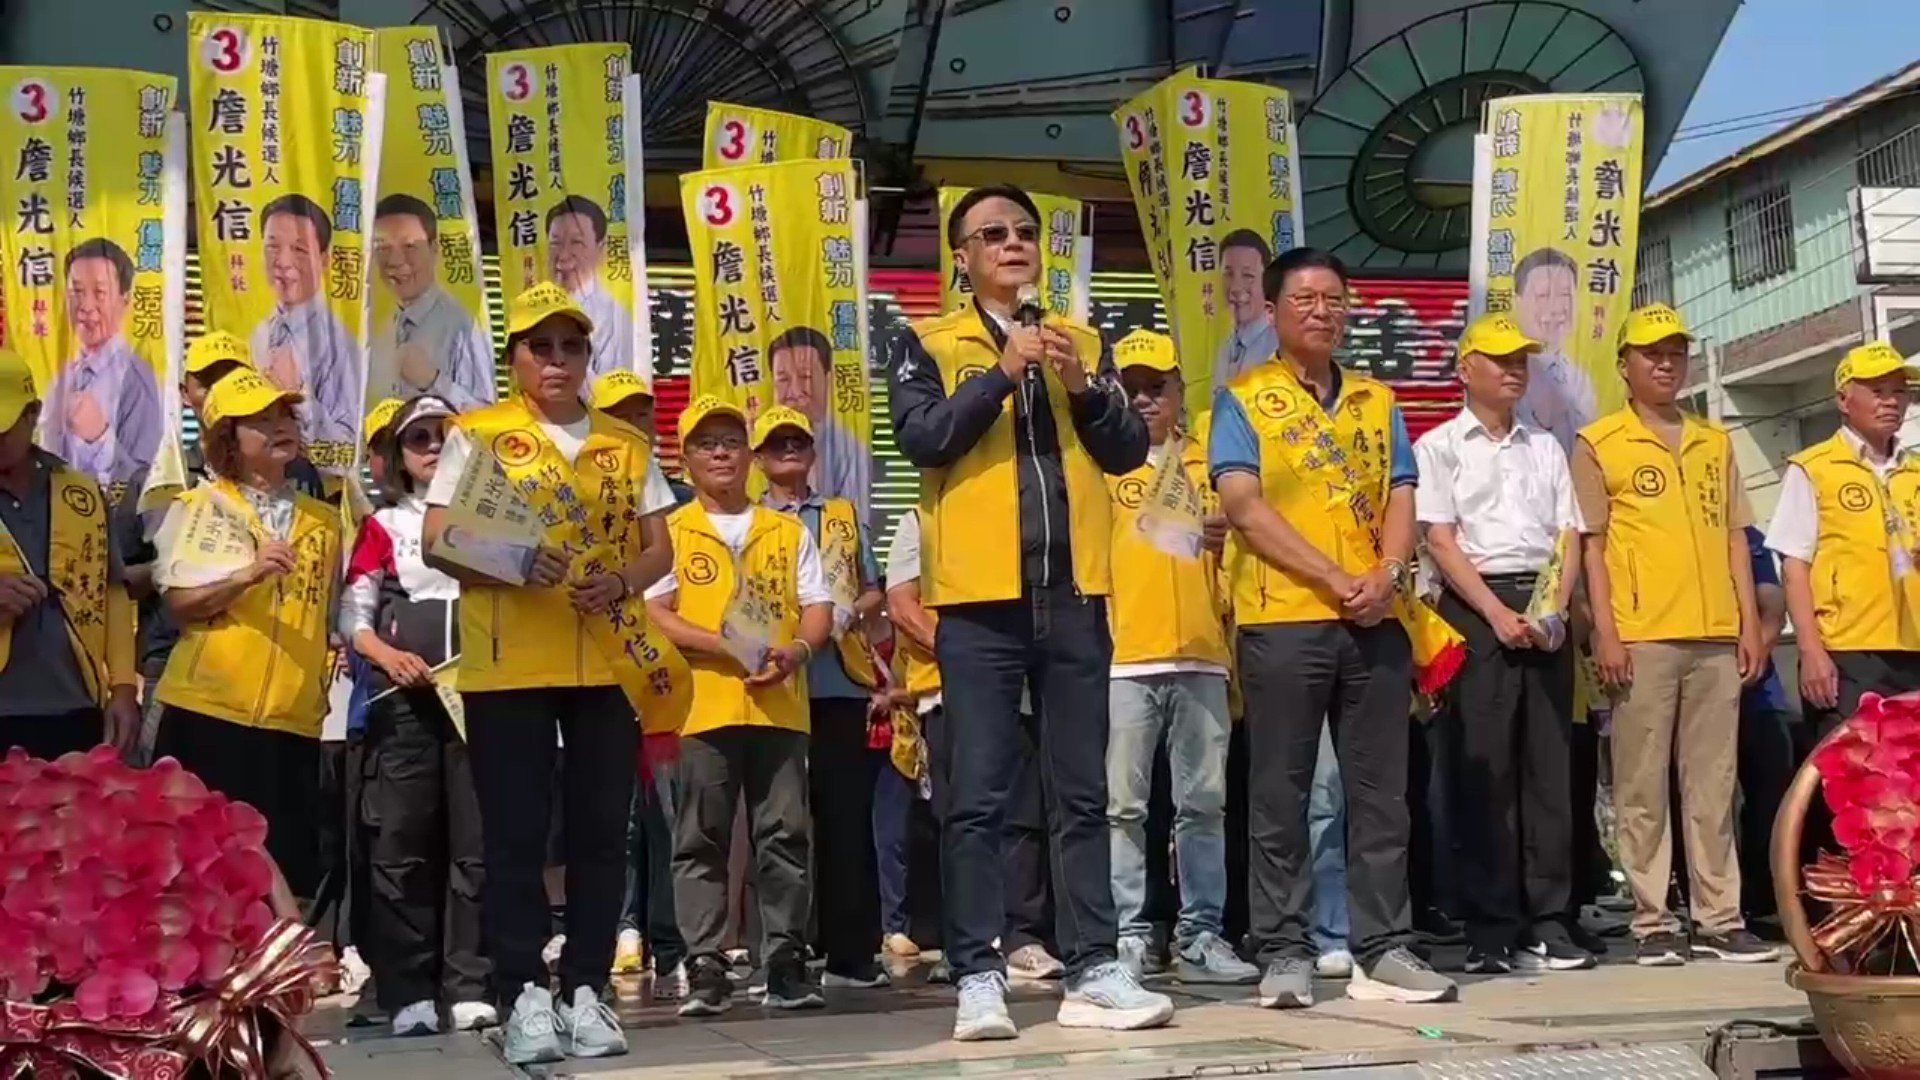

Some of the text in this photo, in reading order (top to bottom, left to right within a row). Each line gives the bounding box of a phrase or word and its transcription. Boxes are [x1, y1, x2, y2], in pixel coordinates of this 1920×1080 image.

[20, 83, 48, 122] 3
[211, 30, 240, 72] 3
[260, 36, 280, 184] 竹塘鄉長候選人
[506, 64, 530, 101] 3
[1182, 91, 1205, 126] 3
[67, 87, 86, 229] 竹塘鄉長候選人
[208, 88, 253, 241] 詹光信
[331, 38, 366, 300] 創新 魅力 優質 活力
[405, 38, 473, 284] 創新 魅力 優質 活力
[505, 113, 540, 248] 詹光信
[545, 63, 563, 190] 竹塘鄉長候選人
[720, 121, 746, 160] 3
[1126, 115, 1144, 149] 3
[15, 137, 56, 288] 詹光信
[132, 83, 169, 339] 創新 魅力 優質 活力
[607, 234, 632, 282] 活力
[704, 186, 733, 226] 3
[748, 184, 783, 323] 竹塘鄉長候選人
[1181, 141, 1218, 273] 詹光信
[712, 240, 763, 387] 詹光信
[815, 172, 865, 413] 創新 魅力 優質 活力
